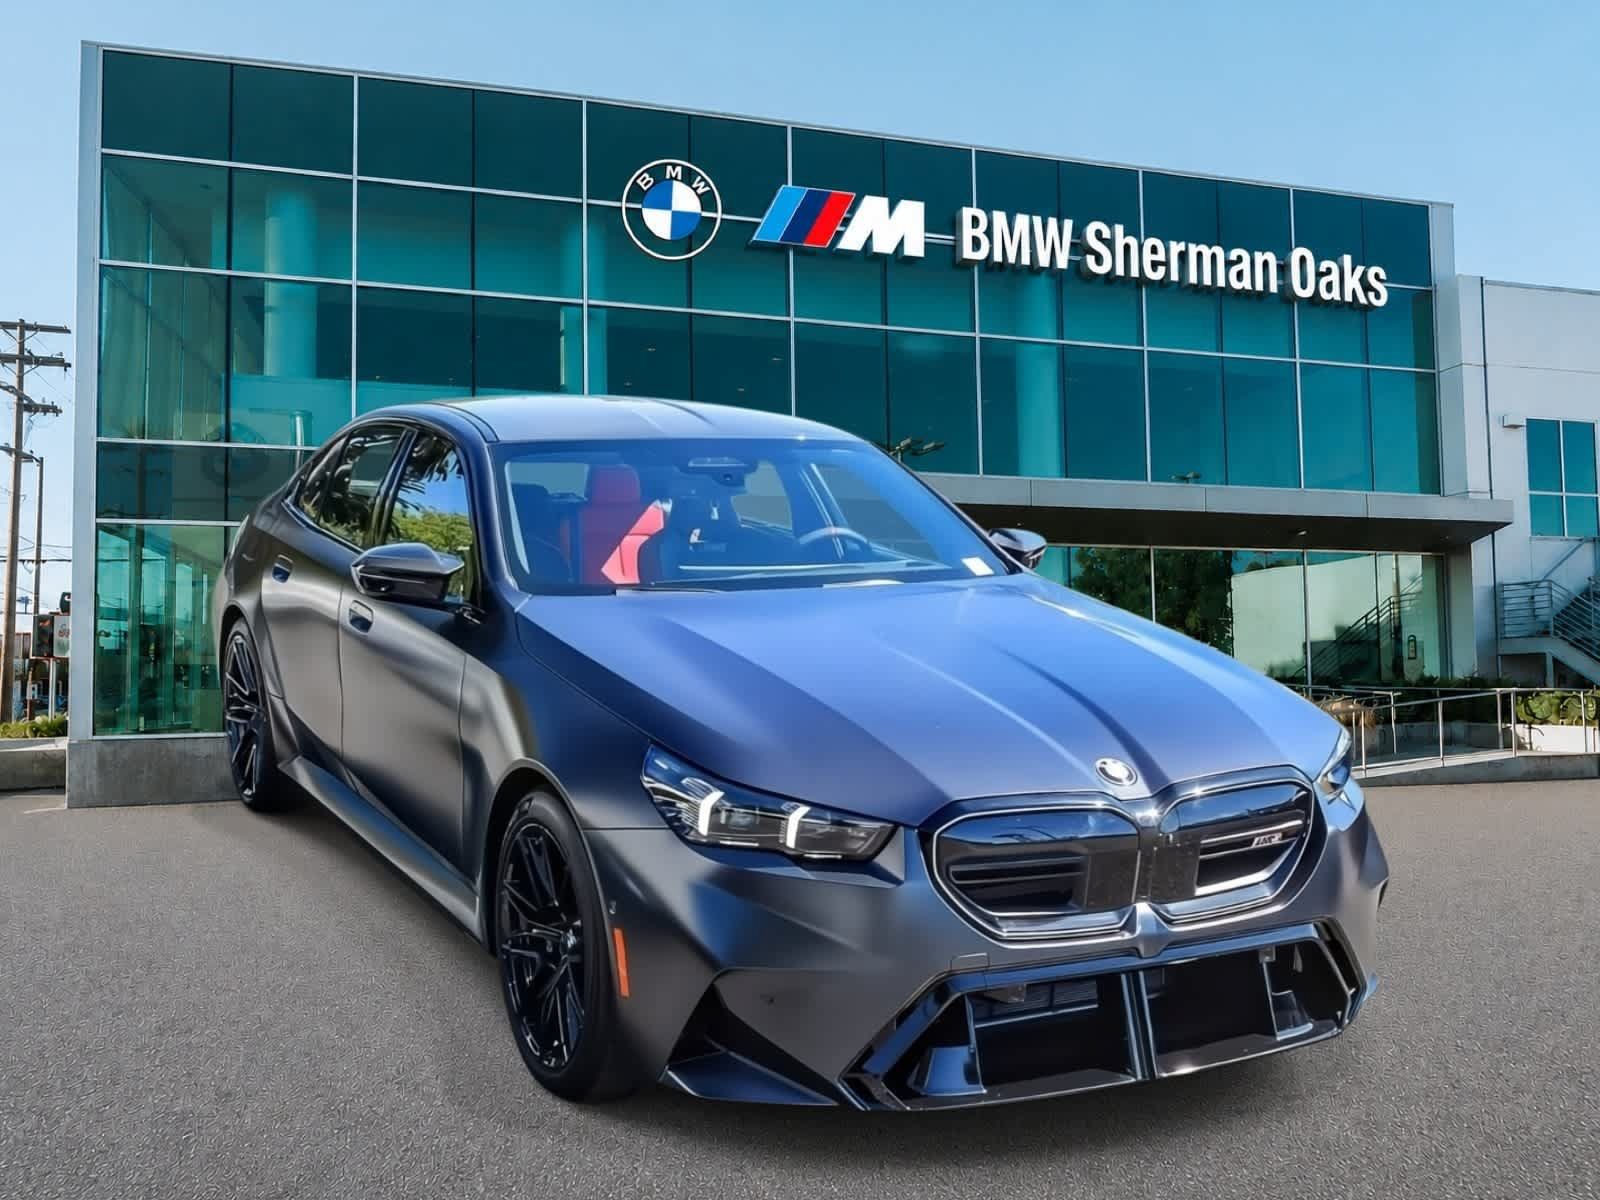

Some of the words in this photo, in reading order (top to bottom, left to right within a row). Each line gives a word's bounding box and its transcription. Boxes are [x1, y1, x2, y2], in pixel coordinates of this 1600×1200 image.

[636, 165, 711, 195] BMW
[836, 195, 925, 257] M
[961, 206, 1073, 269] BMW
[1085, 221, 1278, 293] Sherman
[1290, 247, 1389, 307] Oaks
